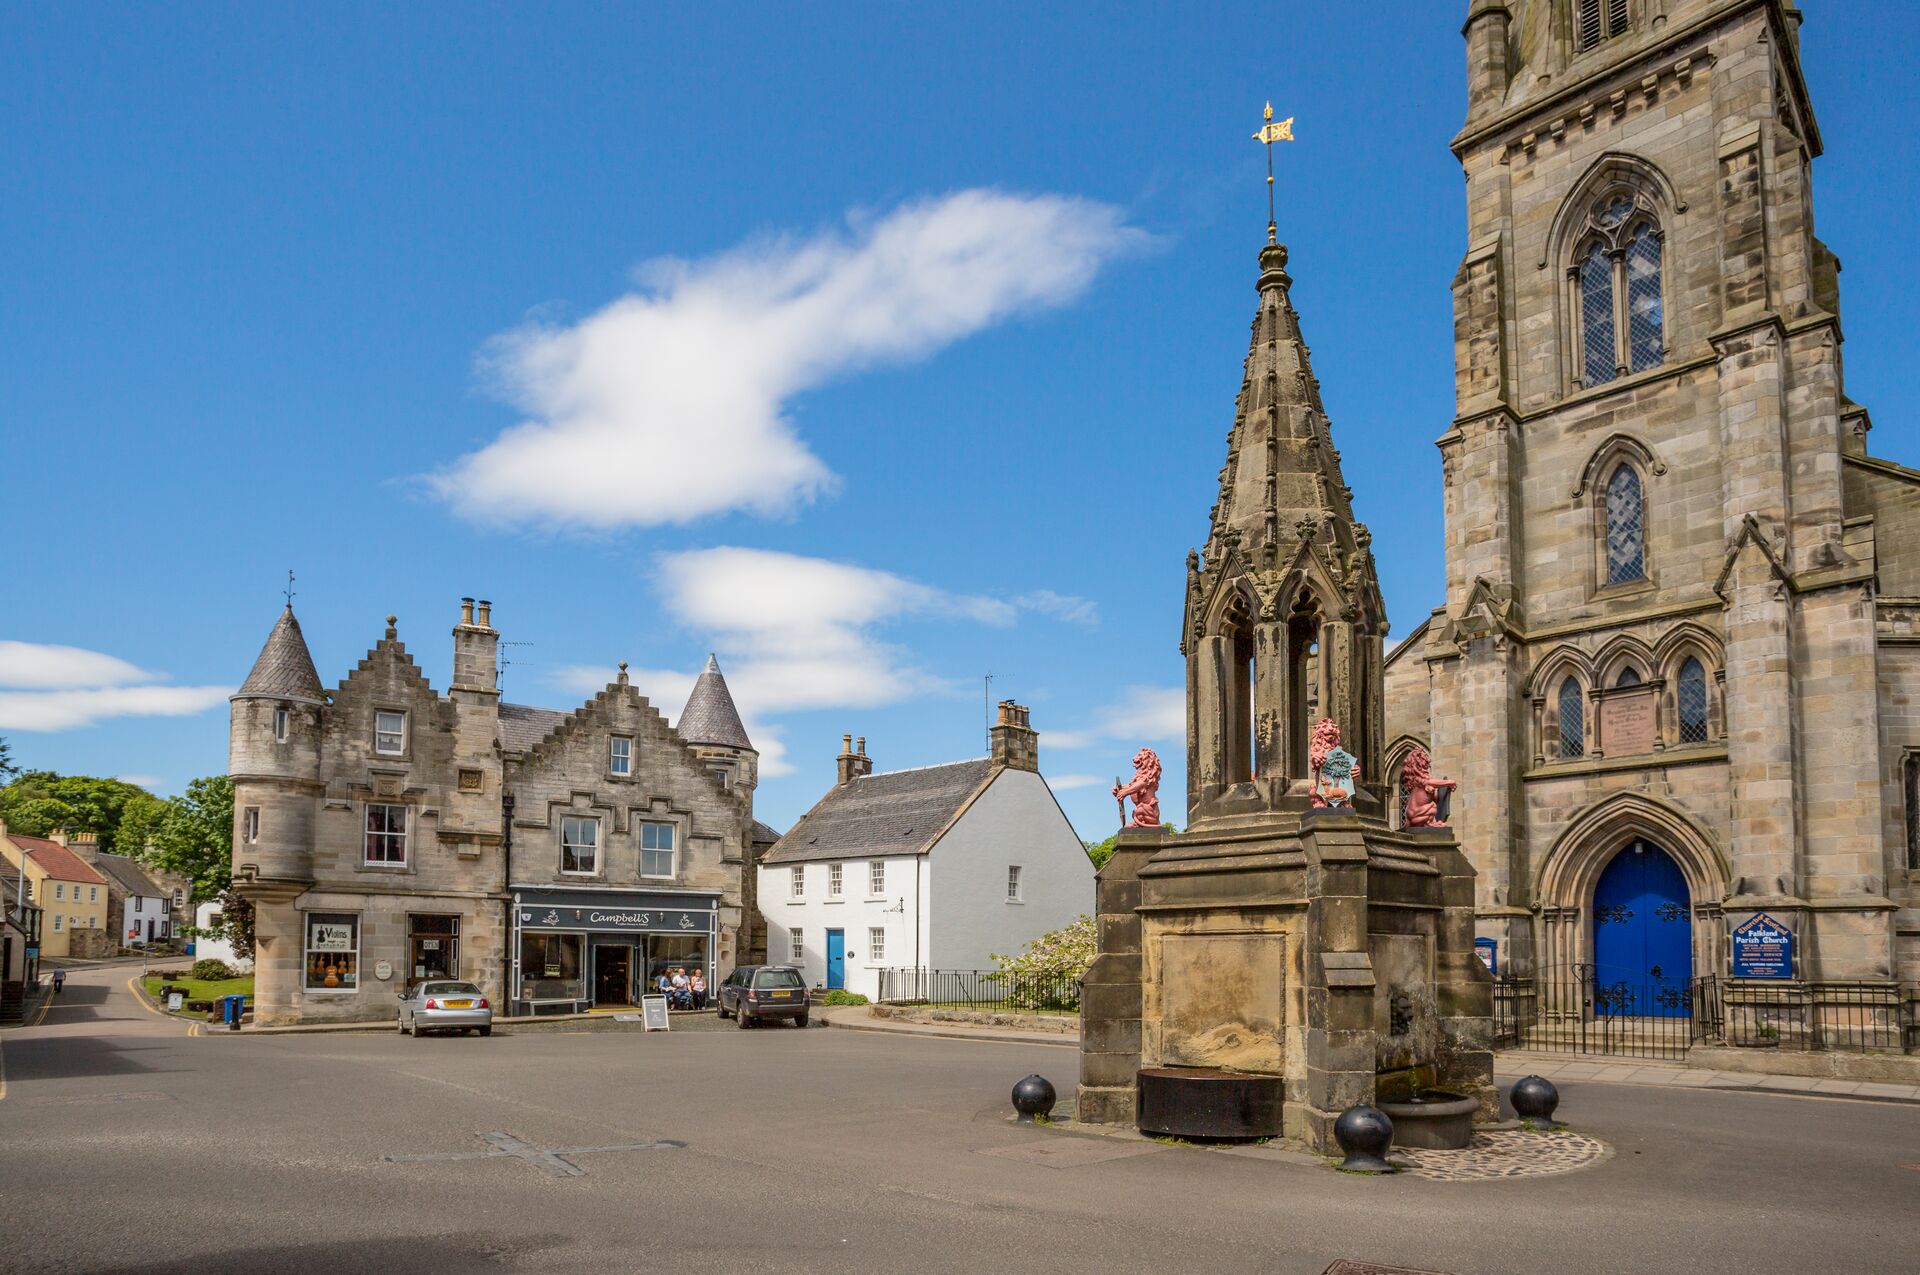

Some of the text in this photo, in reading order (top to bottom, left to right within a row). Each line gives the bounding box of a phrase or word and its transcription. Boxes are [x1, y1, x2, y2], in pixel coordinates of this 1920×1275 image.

[325, 927, 347, 938] Violins
[1738, 919, 1759, 934] Church
[1764, 917, 1789, 935] Scotland
